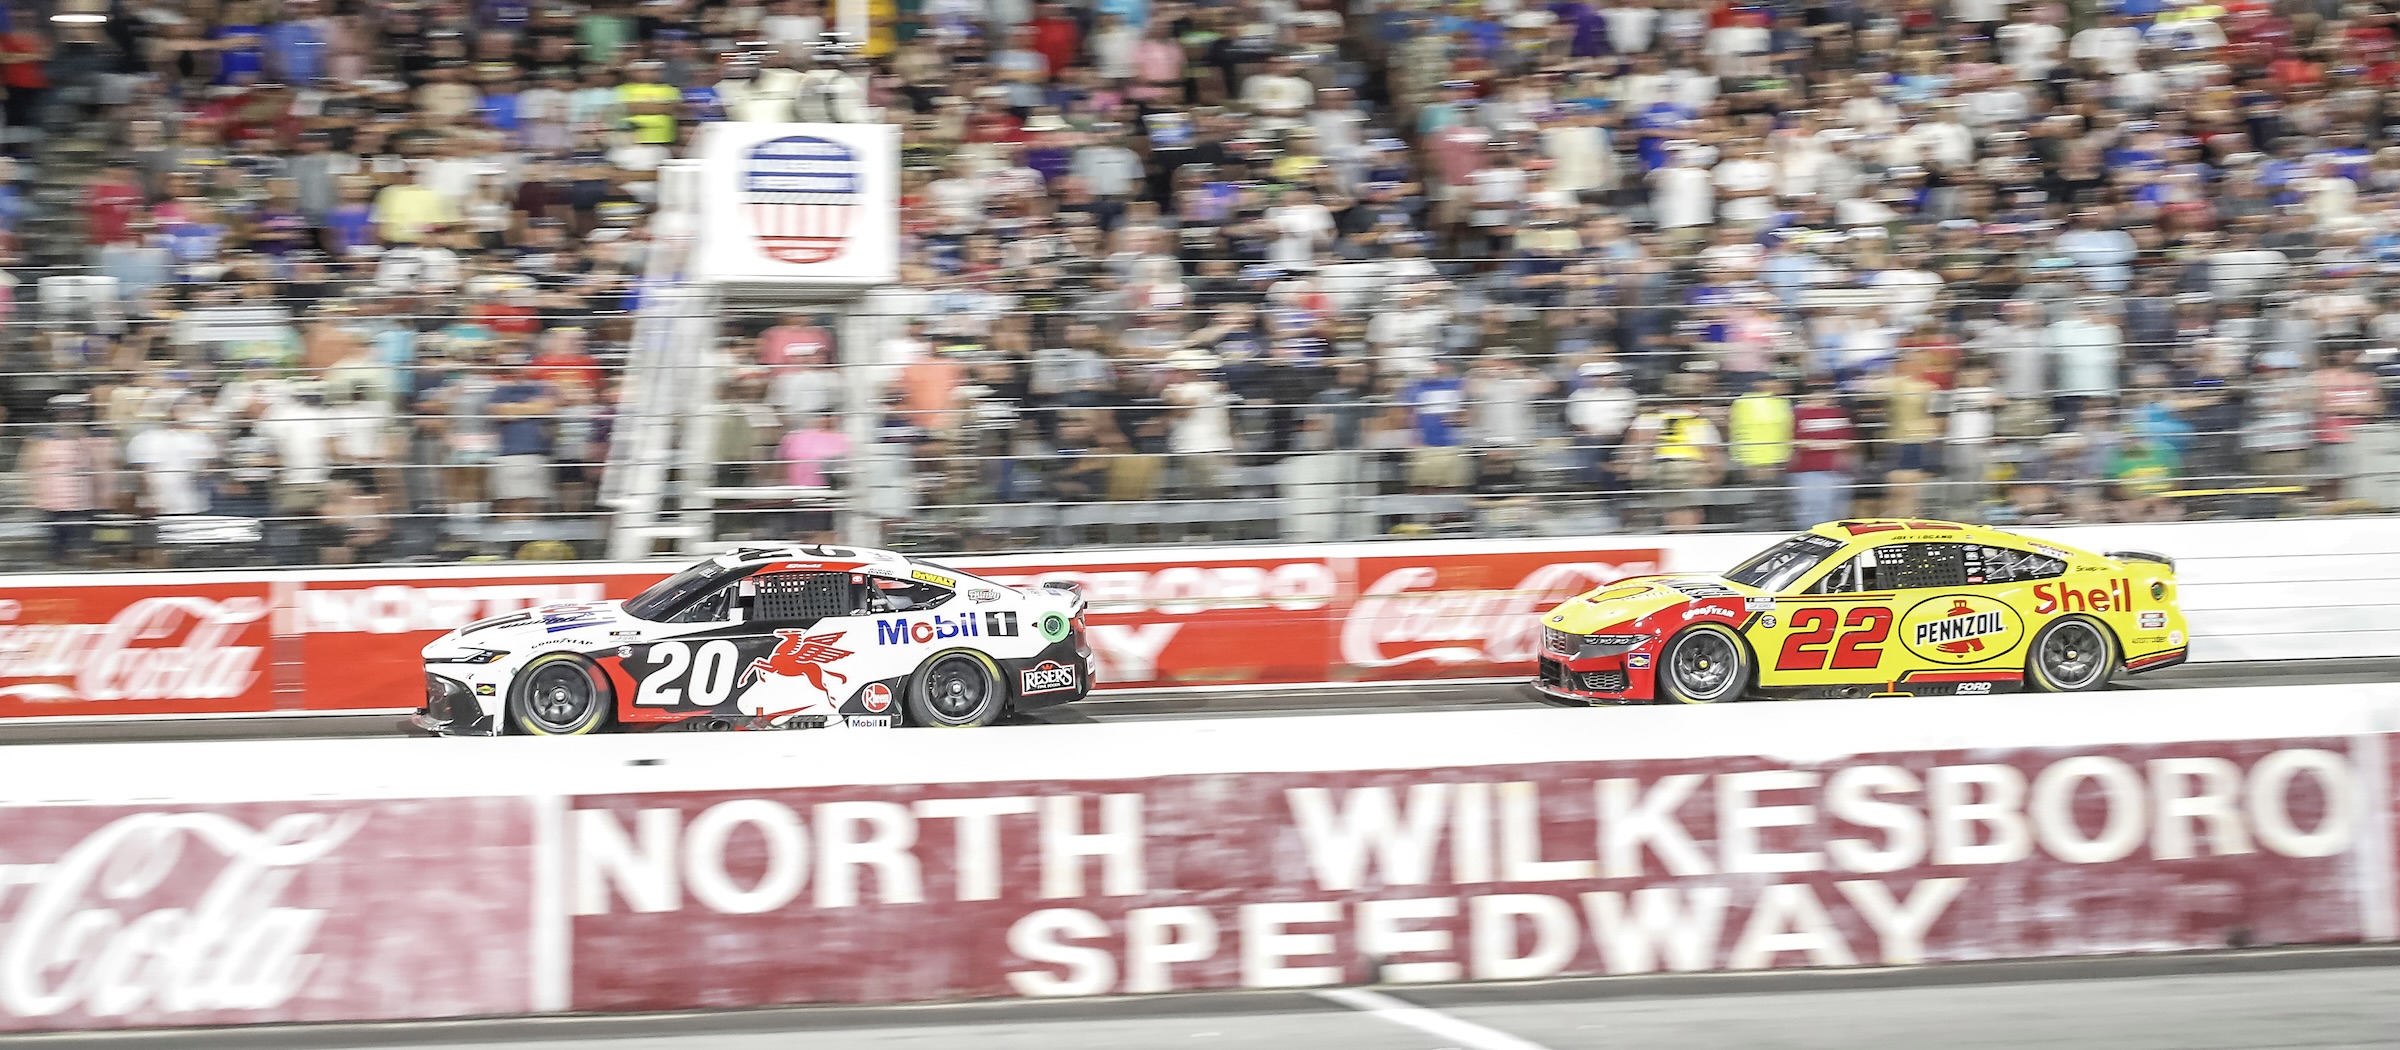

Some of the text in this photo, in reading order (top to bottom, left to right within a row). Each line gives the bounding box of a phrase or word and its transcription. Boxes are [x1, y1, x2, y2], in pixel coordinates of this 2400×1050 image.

[2033, 578, 2131, 614] Shell
[877, 612, 978, 646] Mobil
[1774, 606, 1893, 671] 22
[1916, 612, 2004, 646] PENNZOIL
[635, 640, 739, 707] 20
[1956, 682, 1991, 691] FORD
[852, 719, 877, 728] Mobil
[566, 747, 2356, 916] NORTH WILKESBORO
[1005, 877, 1970, 999] SPEEDWAY
